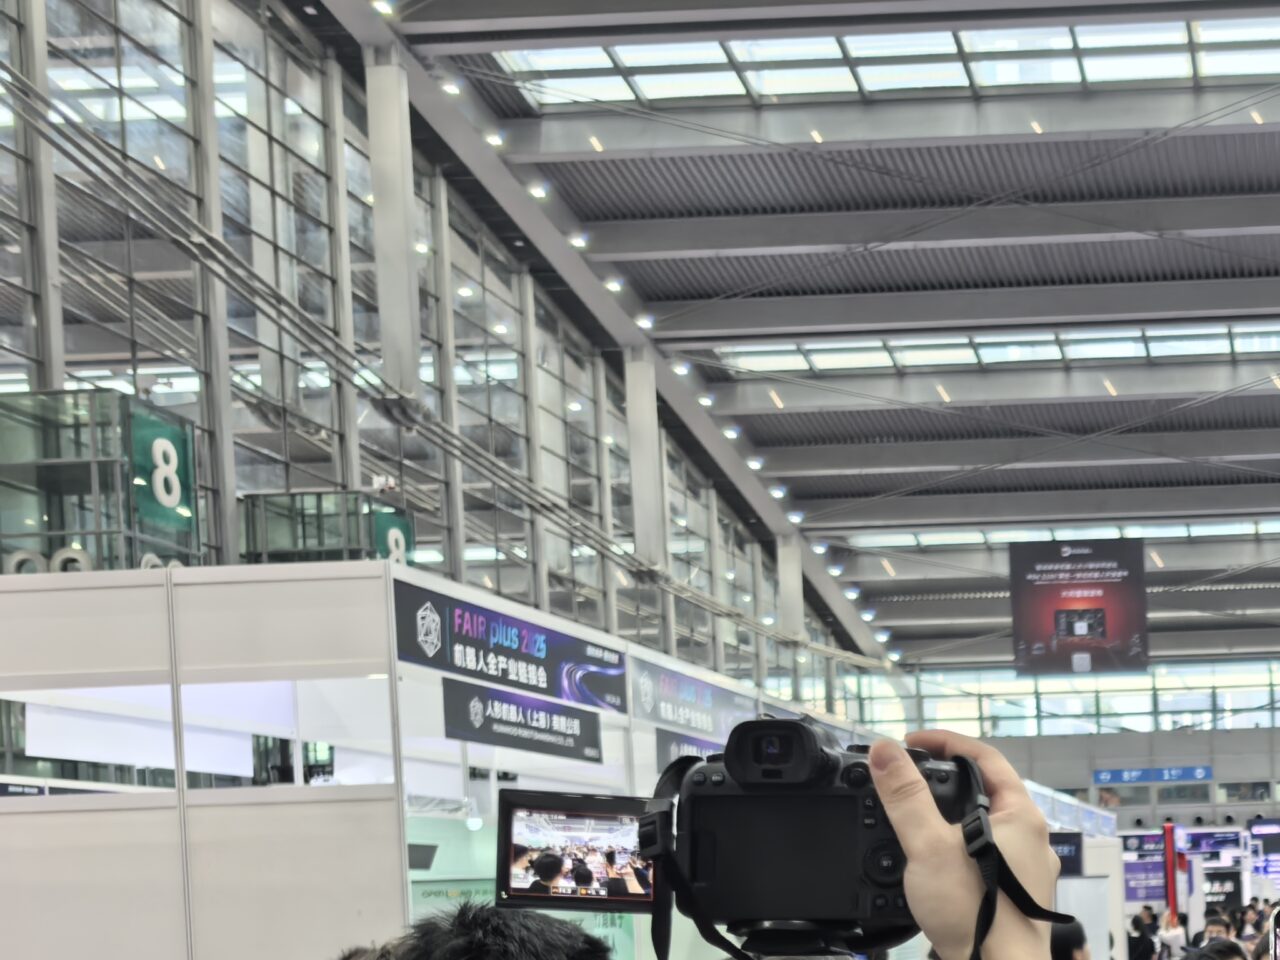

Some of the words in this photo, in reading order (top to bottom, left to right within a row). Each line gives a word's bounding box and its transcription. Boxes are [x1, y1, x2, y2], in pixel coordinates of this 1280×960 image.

[151, 437, 182, 509] 8
[453, 608, 487, 641] FAIR
[489, 618, 520, 650] plus
[453, 644, 548, 689] 机器人全产业链接会
